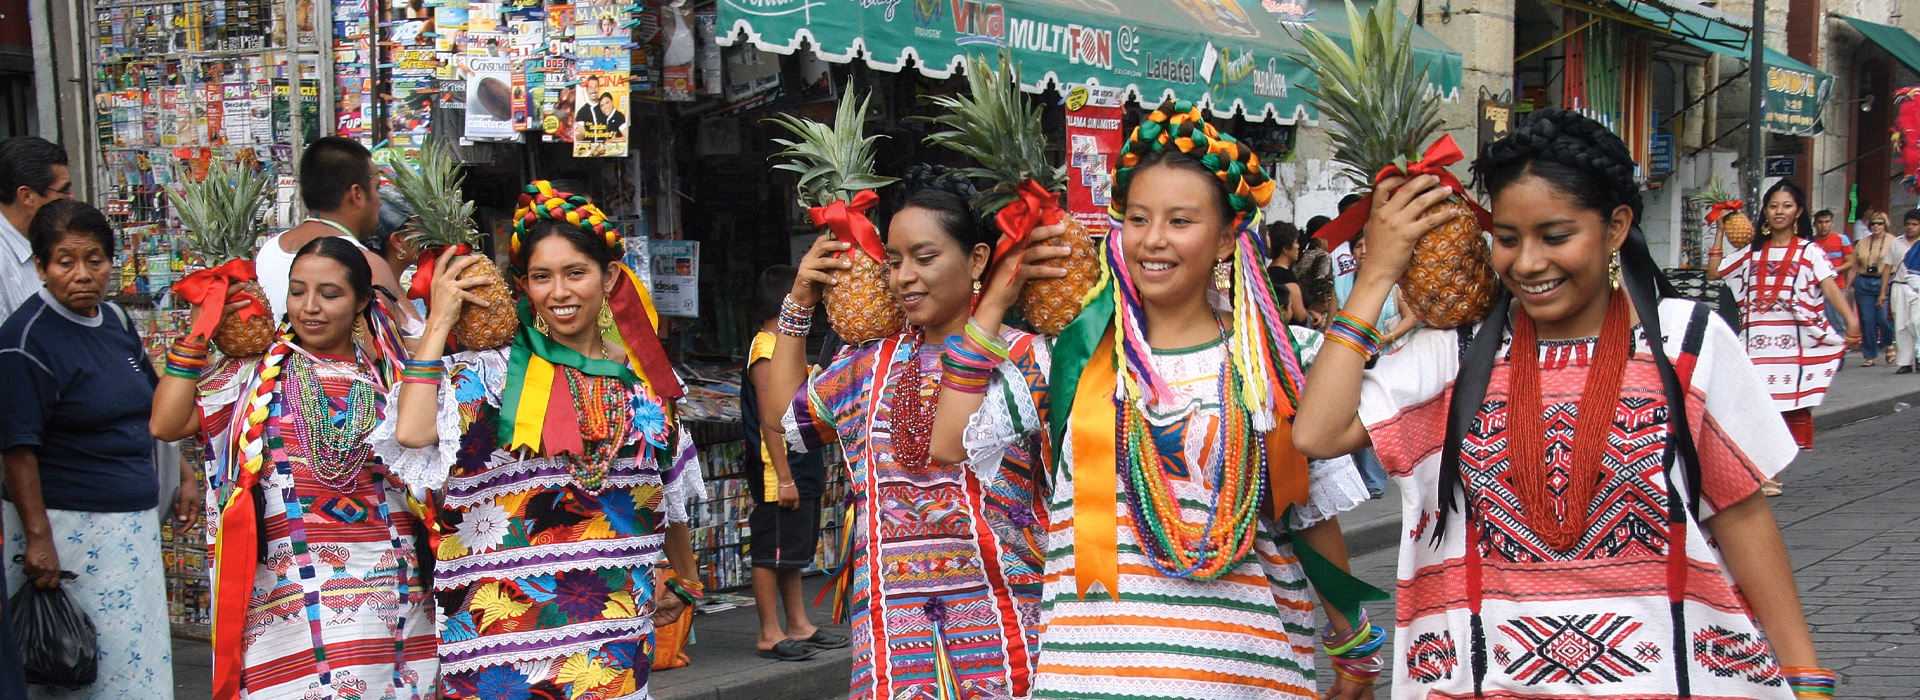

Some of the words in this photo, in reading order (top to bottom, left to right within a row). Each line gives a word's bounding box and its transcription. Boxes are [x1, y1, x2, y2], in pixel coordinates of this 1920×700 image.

[1146, 52, 1196, 85] Ladatel
[579, 74, 625, 88] CCINA
[467, 119, 509, 128] cafeteras
